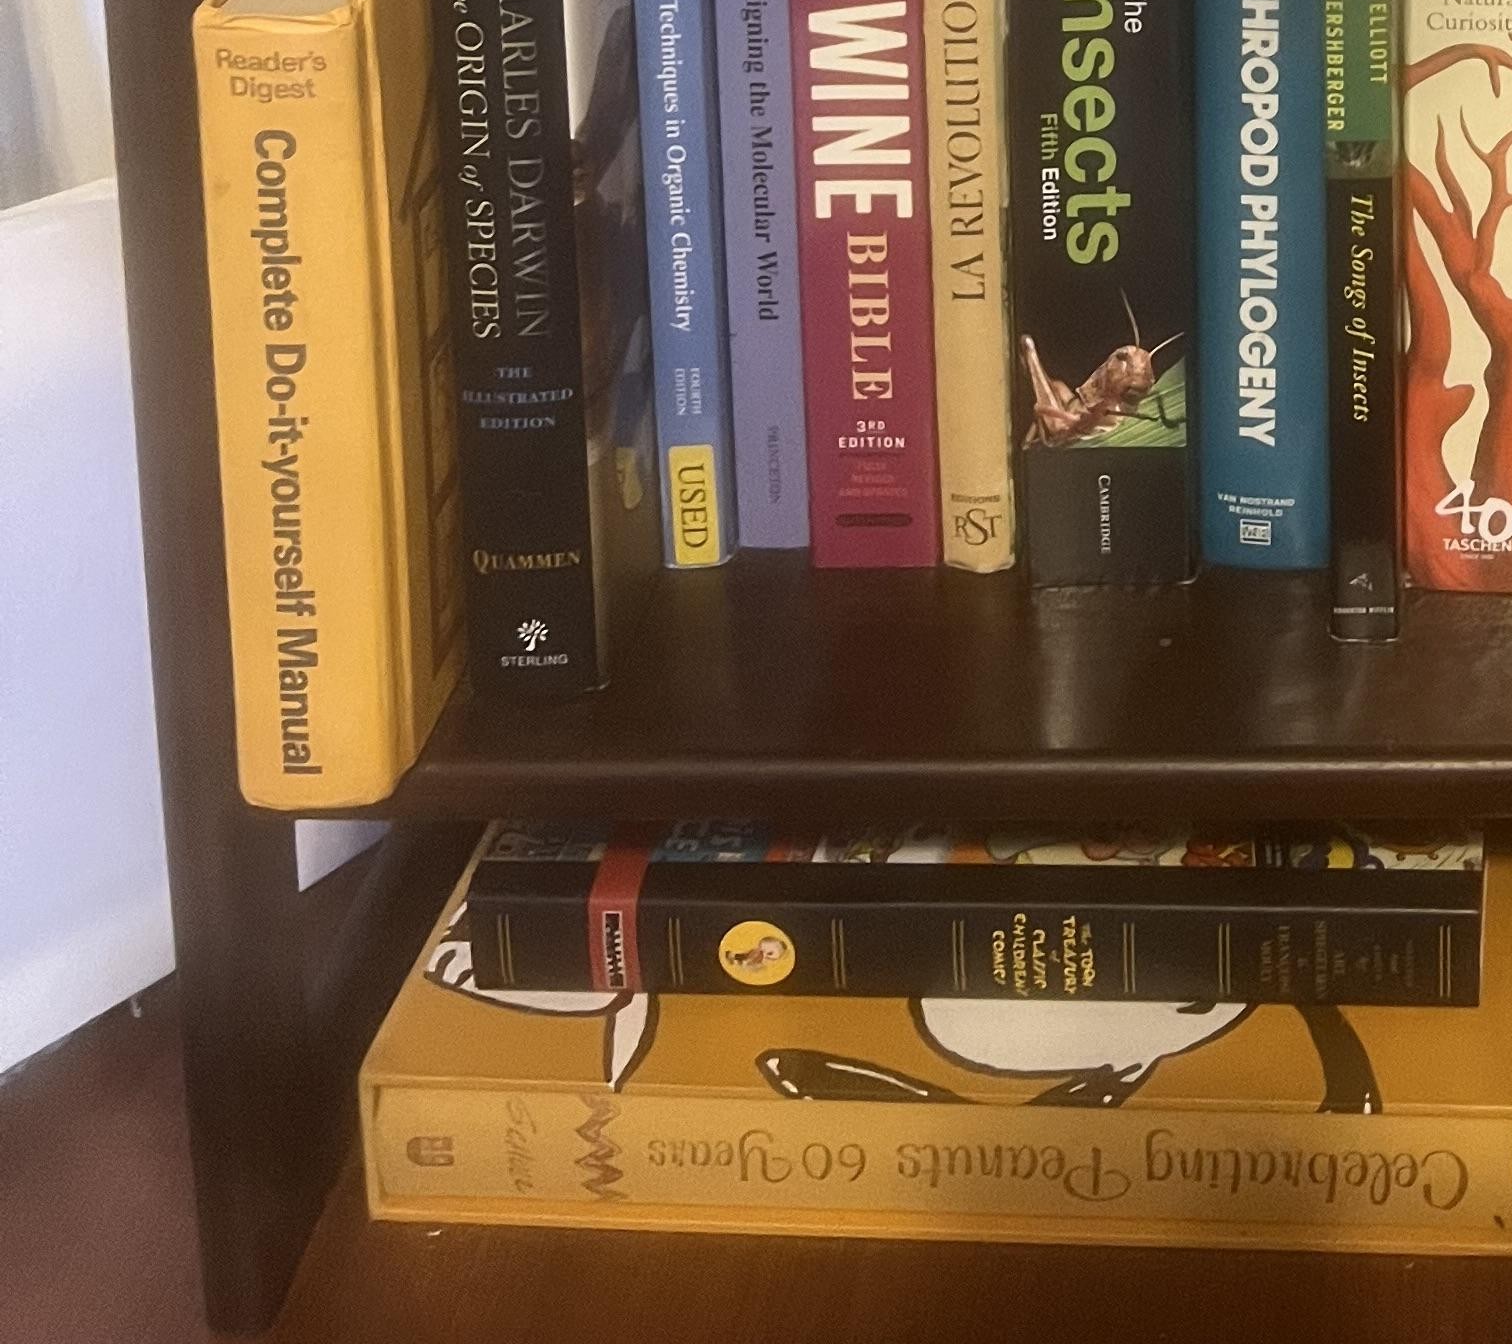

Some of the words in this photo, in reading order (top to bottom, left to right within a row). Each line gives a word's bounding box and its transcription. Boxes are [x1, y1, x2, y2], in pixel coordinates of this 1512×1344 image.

[215, 47, 327, 73] Reader's
[228, 76, 318, 104] Digest
[667, 119, 686, 139] in
[807, 0, 914, 219] WINE
[662, 145, 689, 227] Organic
[1349, 194, 1375, 238] The
[250, 128, 303, 333] Complete
[506, 157, 550, 338] DARWIN
[670, 231, 696, 333] Chemistry
[1343, 241, 1375, 309] Songs
[846, 231, 894, 401] BIBLE
[1238, 194, 1279, 448] PHYLOGENY
[1344, 315, 1376, 344] of
[1349, 348, 1376, 423] Insects
[260, 343, 318, 618] Do-it-yourself
[678, 463, 709, 550] USED
[1098, 474, 1112, 555] CAMBRIDGE
[500, 652, 569, 668] STERLING
[275, 628, 323, 776] Manual
[647, 1129, 789, 1185] Years
[801, 1142, 867, 1184] 60
[897, 1143, 1132, 1203] Peanuts
[1144, 1129, 1469, 1211] Celebrating
